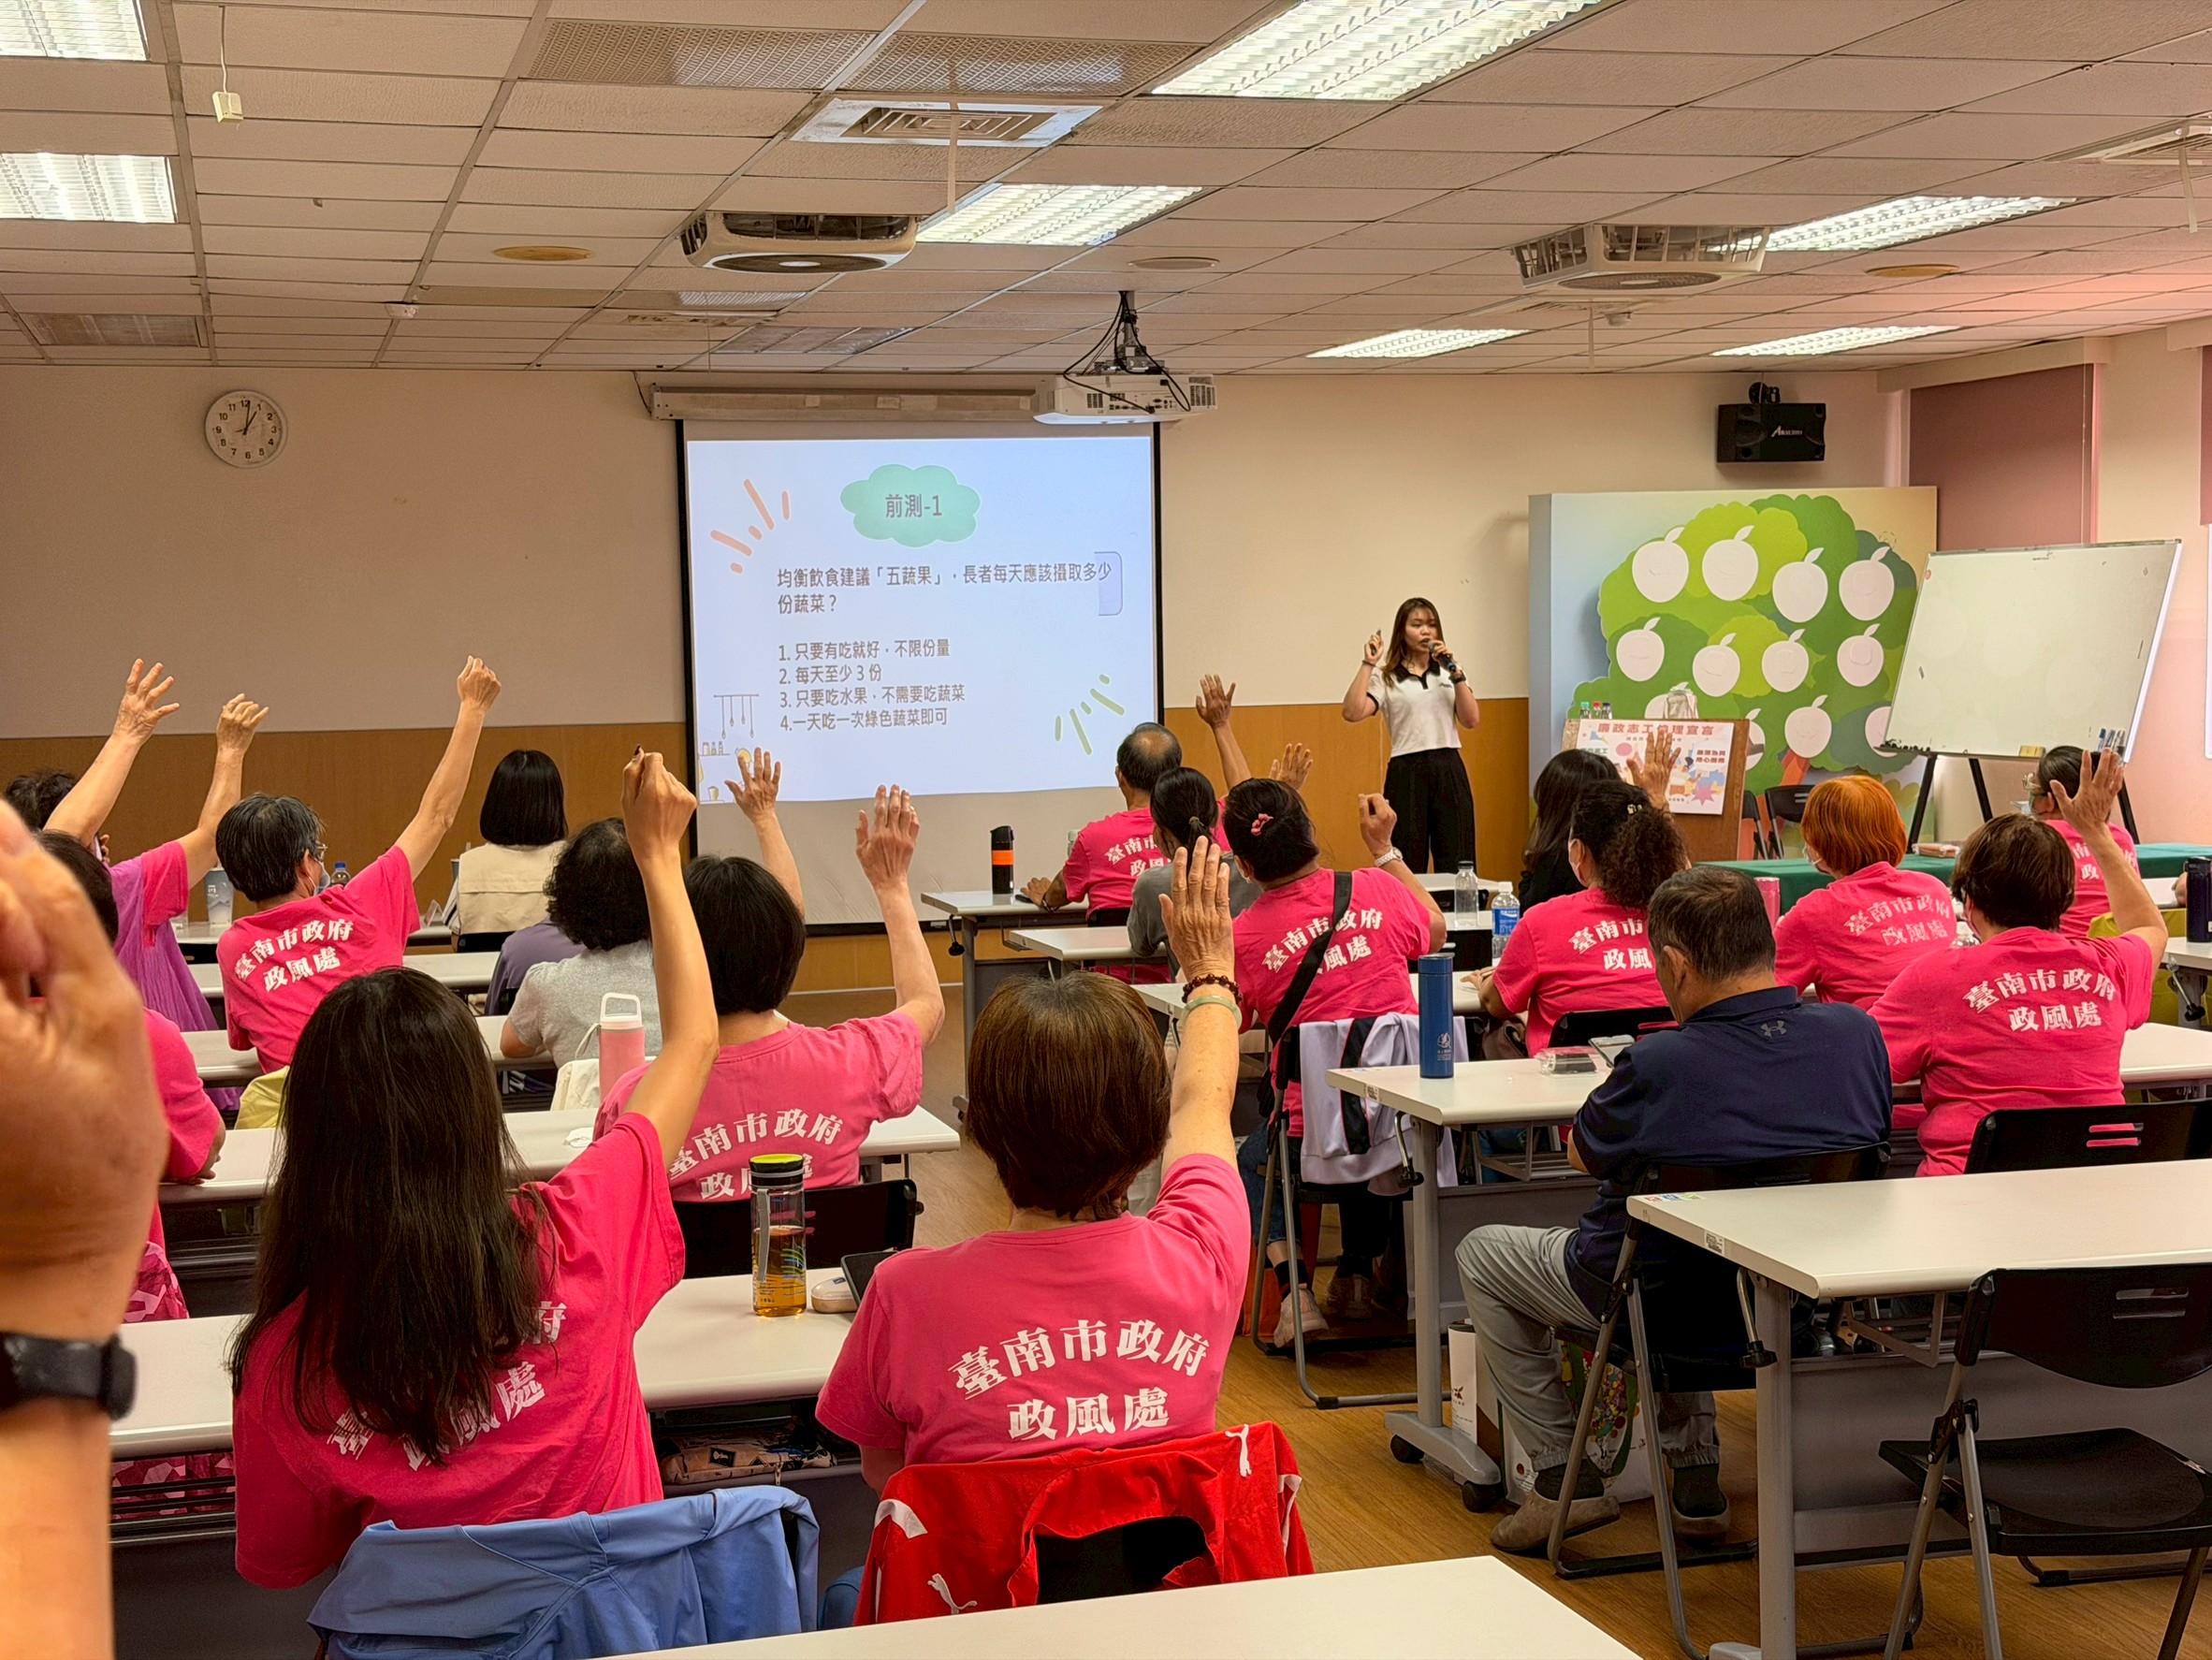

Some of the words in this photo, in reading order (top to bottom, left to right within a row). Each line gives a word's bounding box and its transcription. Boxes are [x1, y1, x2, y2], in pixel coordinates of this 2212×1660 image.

[215, 426, 222, 434] 9
[267, 413, 273, 421] 2
[270, 426, 277, 434] 3
[885, 493, 942, 518] 前測-1
[778, 593, 837, 615] 份蔬菜？
[795, 664, 852, 685] 每天至少
[234, 918, 354, 982] 臺南市政府
[263, 945, 341, 992] 政風處
[1963, 968, 2117, 1013] 臺南市政府
[2008, 1001, 2102, 1031] 政風處
[947, 1318, 1210, 1401] 臺南市政府
[1007, 1387, 1170, 1441] 政風處
